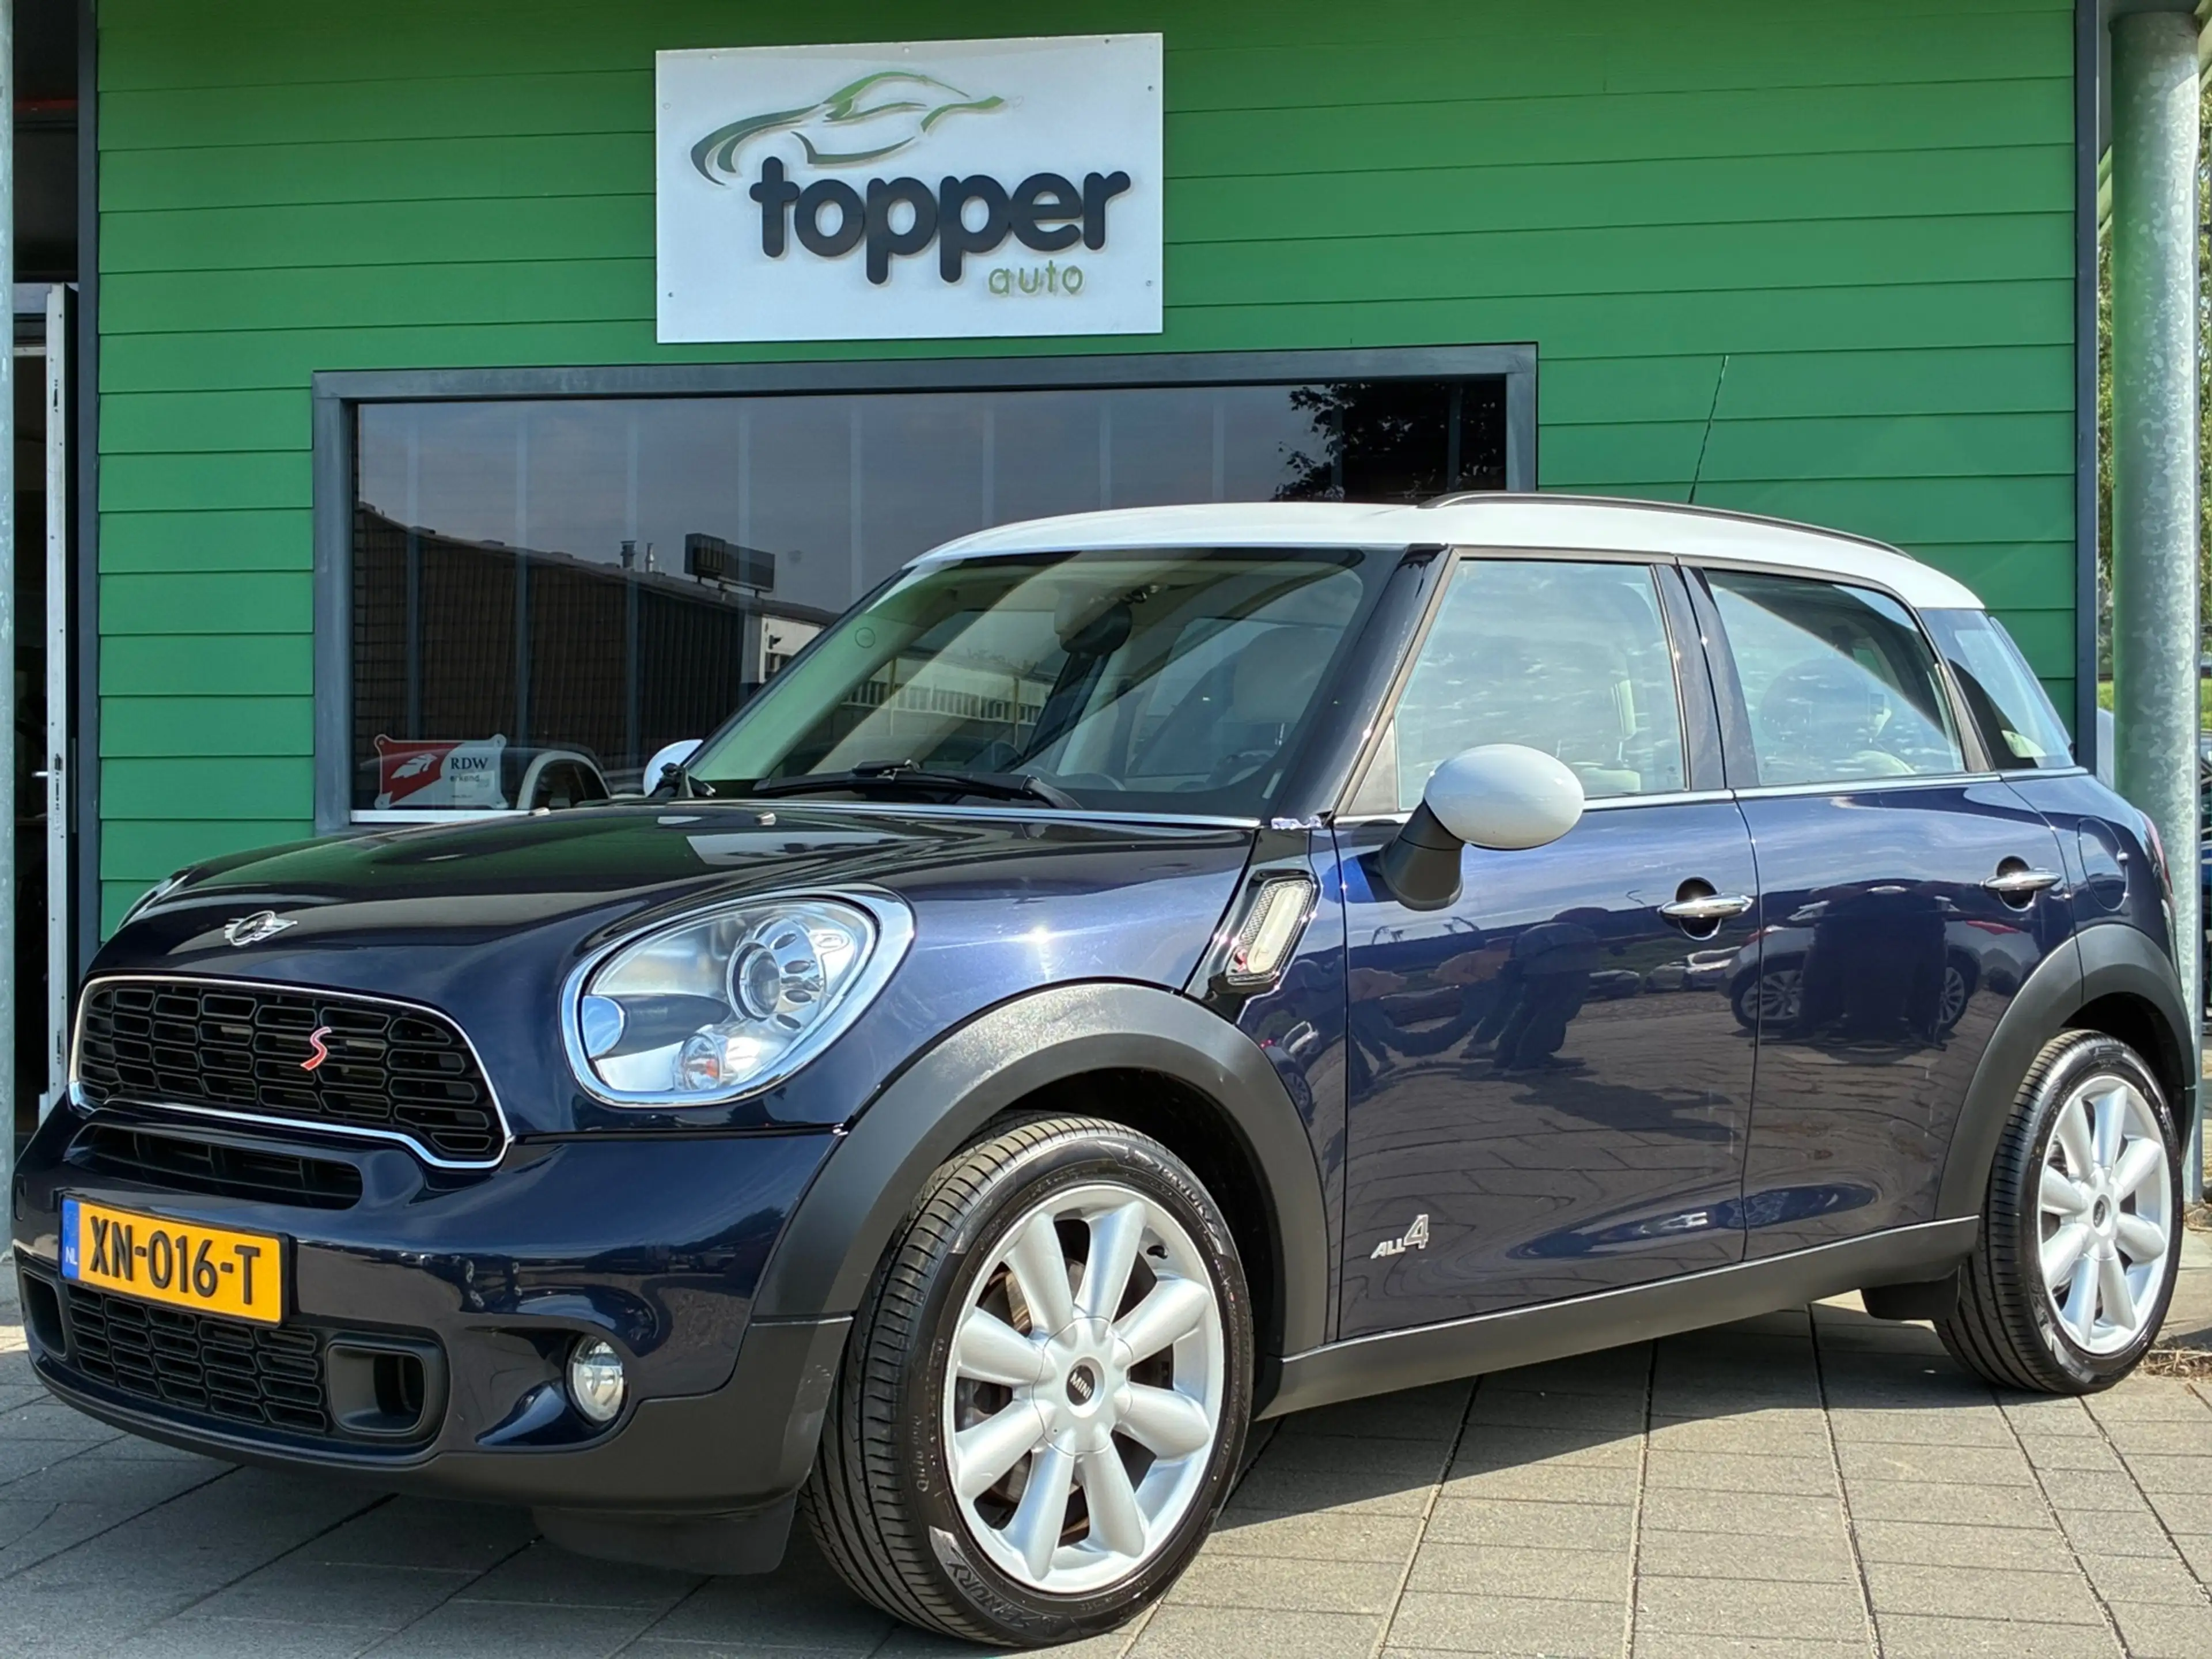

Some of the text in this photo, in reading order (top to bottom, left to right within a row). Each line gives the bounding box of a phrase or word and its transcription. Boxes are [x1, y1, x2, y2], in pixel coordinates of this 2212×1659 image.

[749, 156, 1131, 285] topper
[988, 259, 1083, 294] auto
[450, 757, 488, 770] RDW
[450, 774, 480, 782] erkend
[300, 1027, 332, 1071] S
[65, 1246, 78, 1266] NL
[90, 1216, 260, 1305] XN-016-T
[1070, 1370, 1092, 1400] MINI
